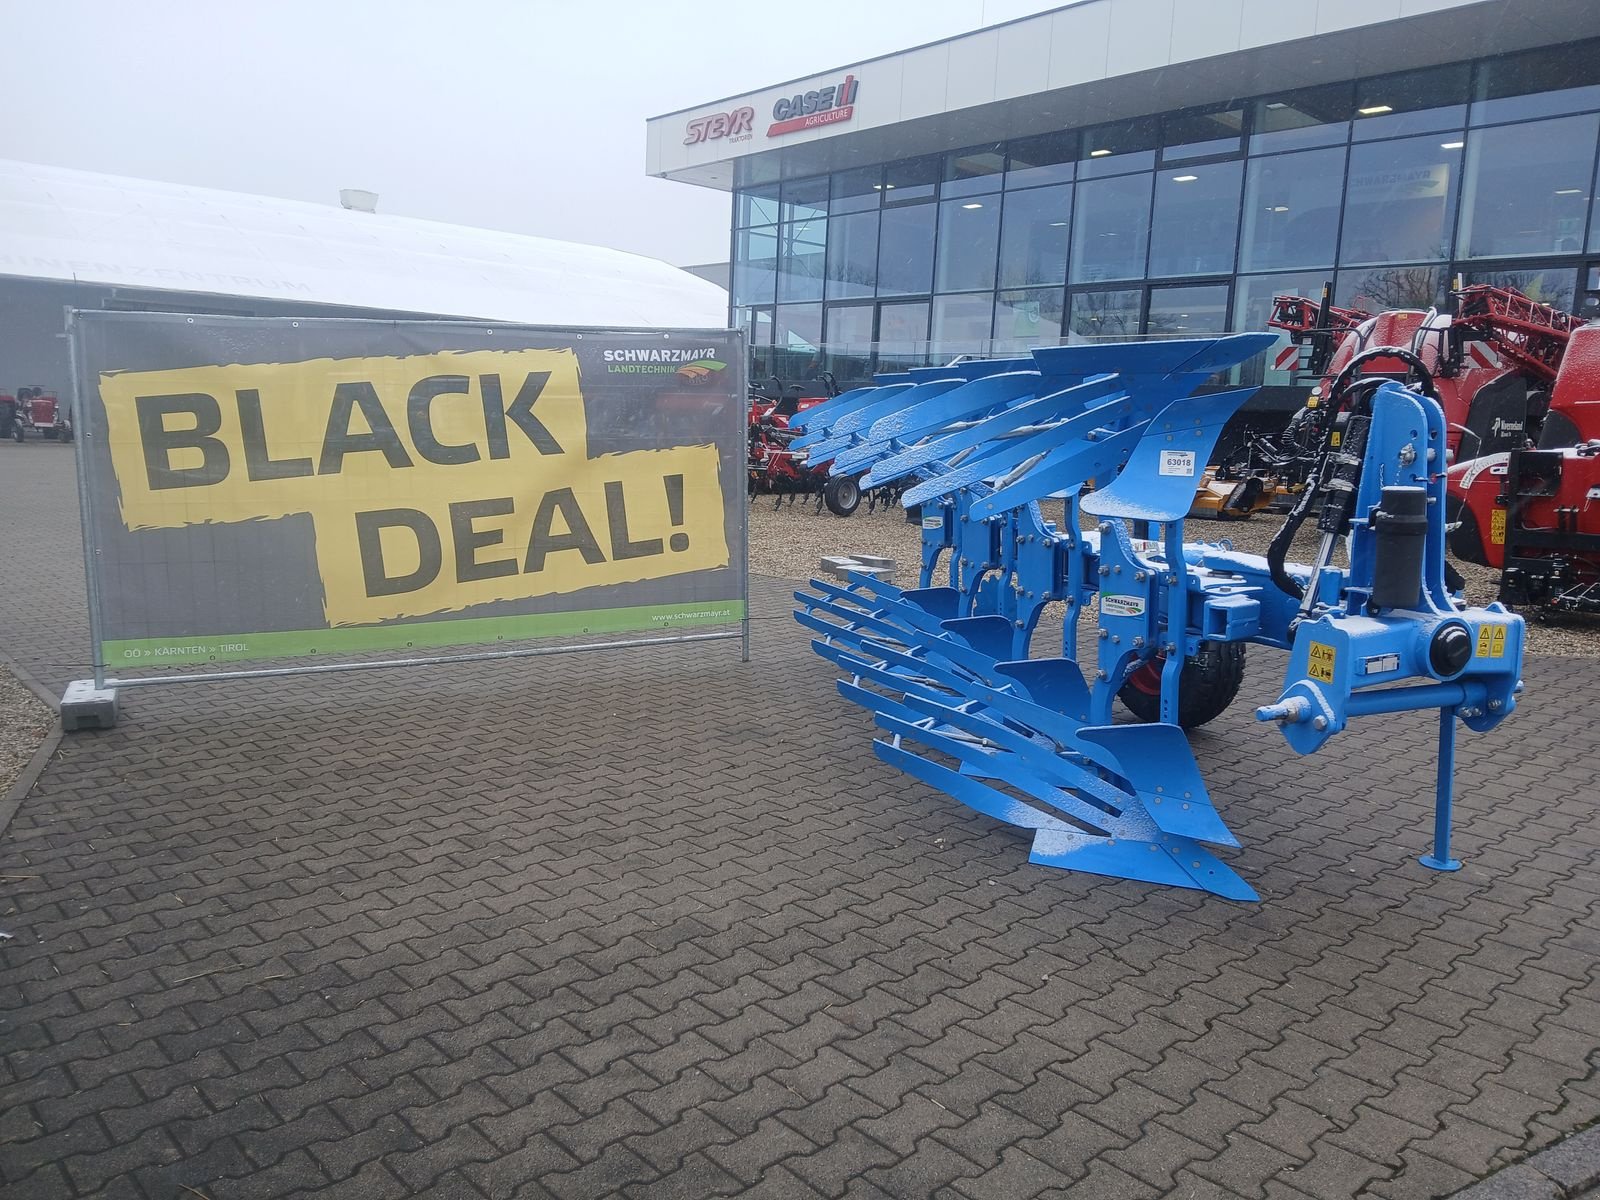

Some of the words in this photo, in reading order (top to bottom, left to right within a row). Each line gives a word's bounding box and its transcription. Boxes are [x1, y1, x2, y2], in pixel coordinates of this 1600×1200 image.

[772, 86, 836, 121] CASE
[683, 106, 754, 145] STEYR
[804, 109, 849, 127] AGRICULTURE
[603, 347, 716, 362] SCHWARZMAYR
[607, 364, 676, 374] LANDTECHNIK
[135, 371, 565, 491] BLACK
[1167, 458, 1191, 467] 63018
[355, 473, 690, 598] DEAL!
[651, 610, 730, 620] www.schwarzmayr.at
[219, 643, 249, 653] TIROL
